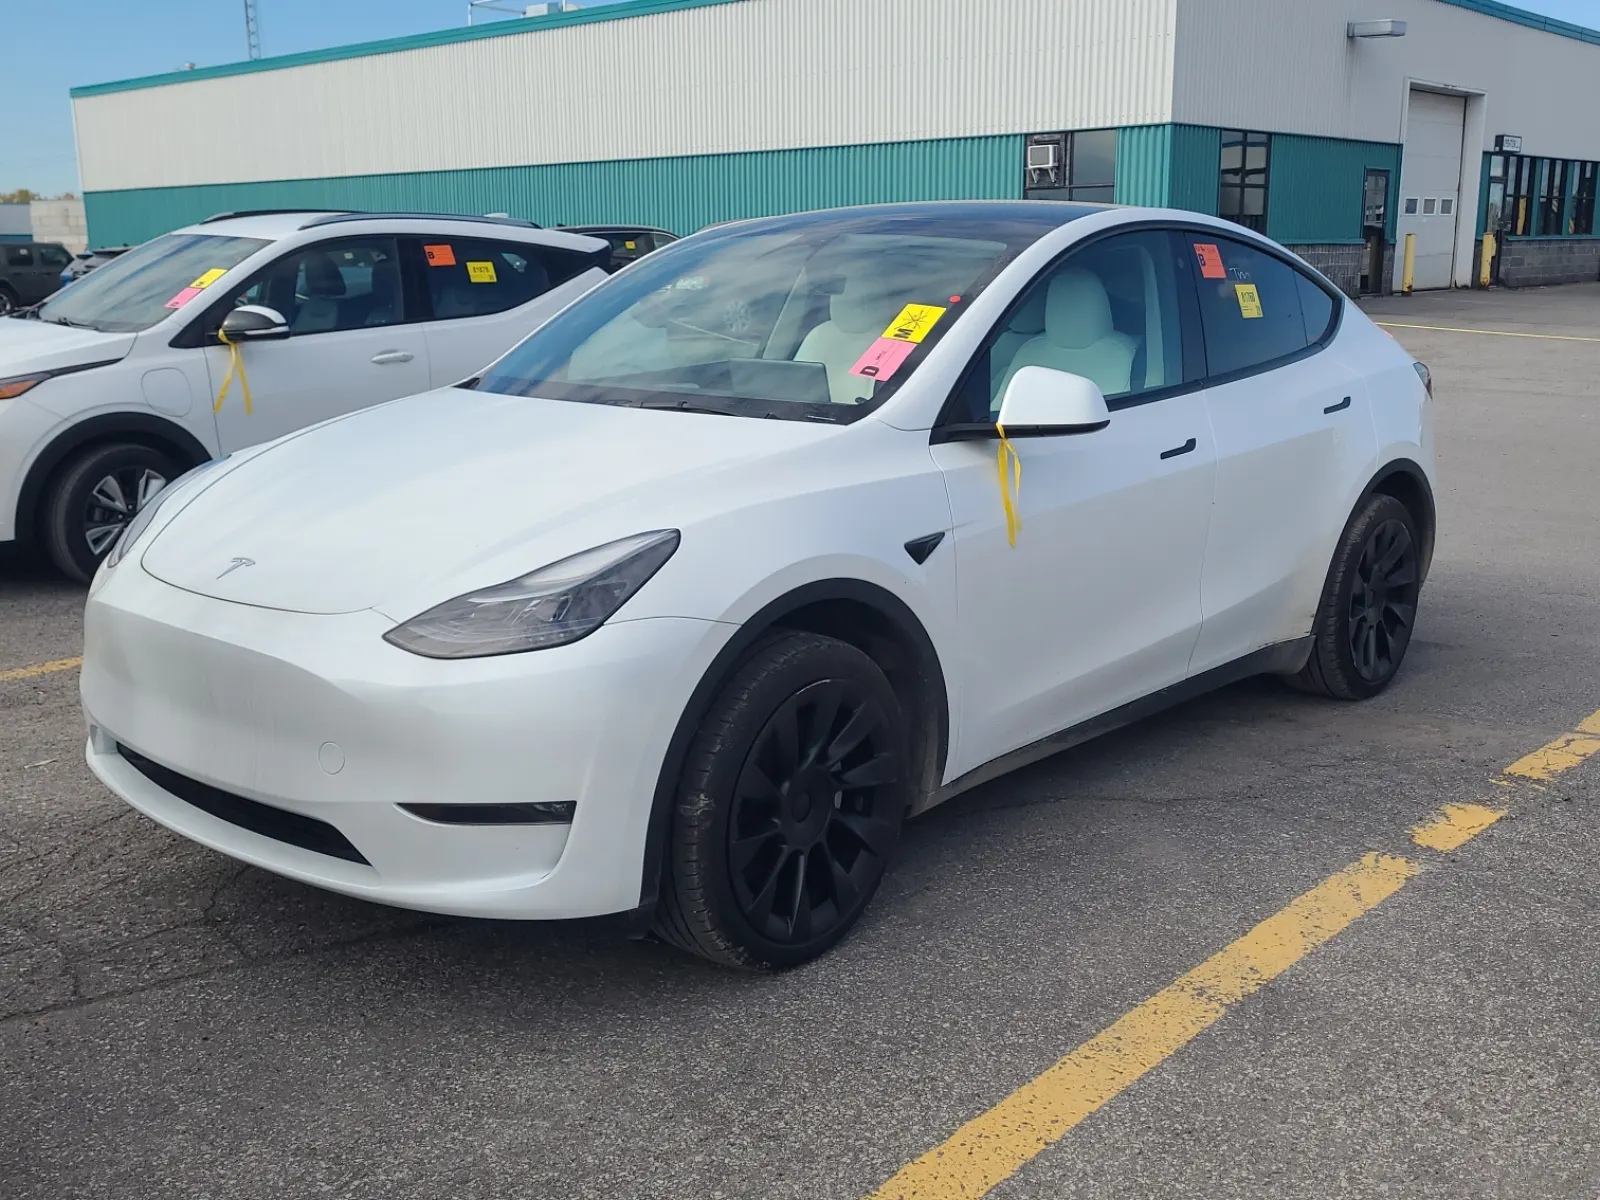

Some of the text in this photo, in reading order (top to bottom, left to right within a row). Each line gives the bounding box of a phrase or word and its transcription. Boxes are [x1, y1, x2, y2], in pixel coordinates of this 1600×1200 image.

[427, 251, 435, 259] B
[1198, 253, 1206, 266] B
[893, 328, 914, 339] M
[859, 365, 880, 377] D
